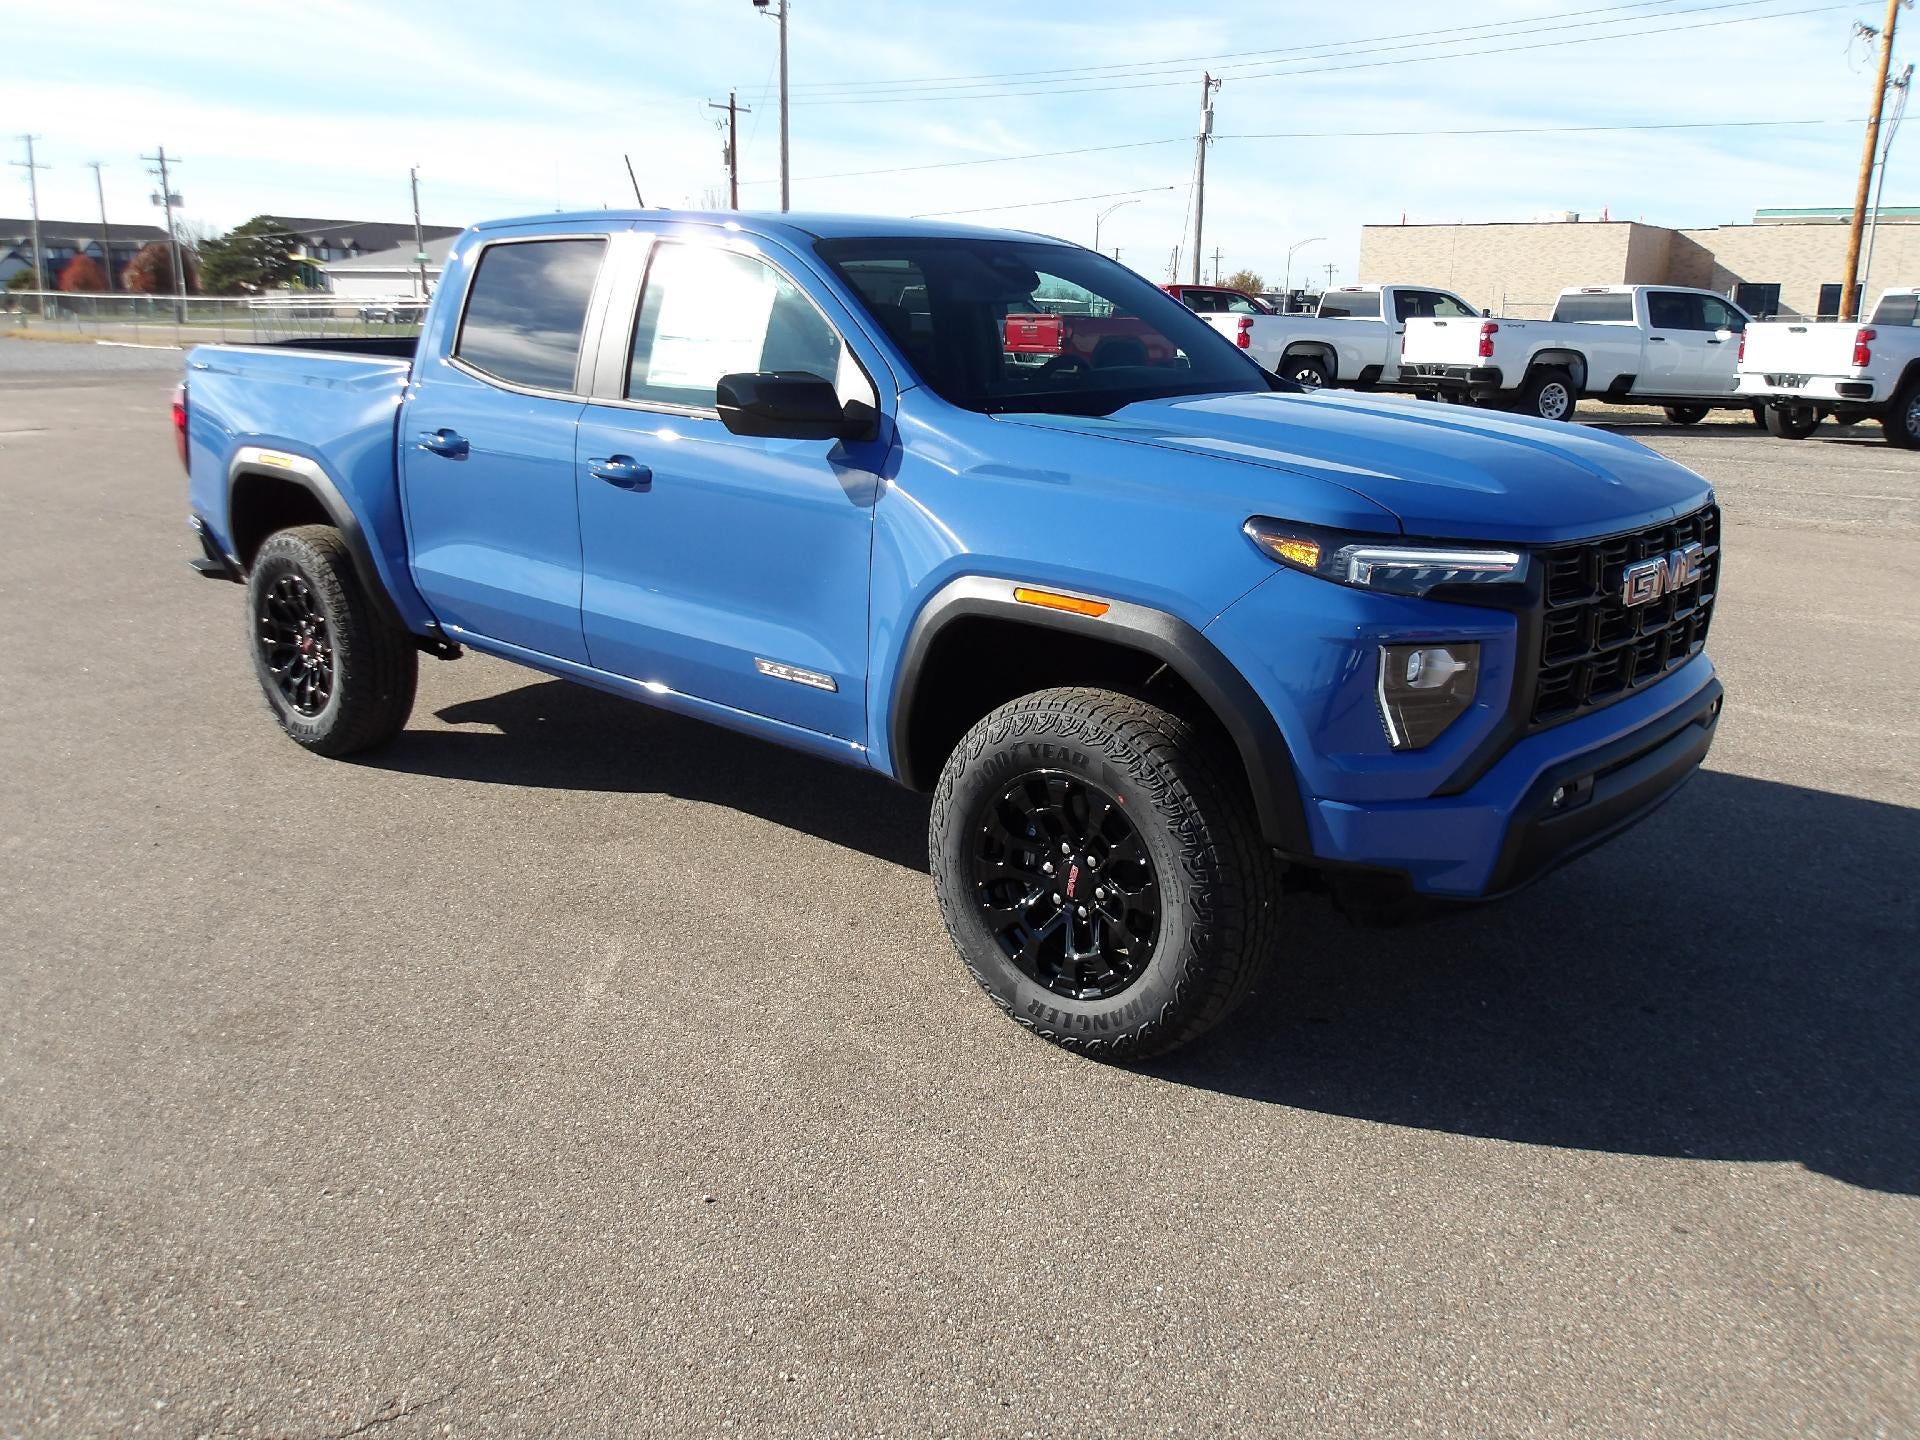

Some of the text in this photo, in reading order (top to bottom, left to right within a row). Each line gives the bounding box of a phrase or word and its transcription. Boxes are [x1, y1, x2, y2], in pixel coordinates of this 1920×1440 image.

[1623, 541, 1704, 607] GMC
[1066, 864, 1079, 898] GMC
[1027, 986, 1159, 1032] WRANGLER
